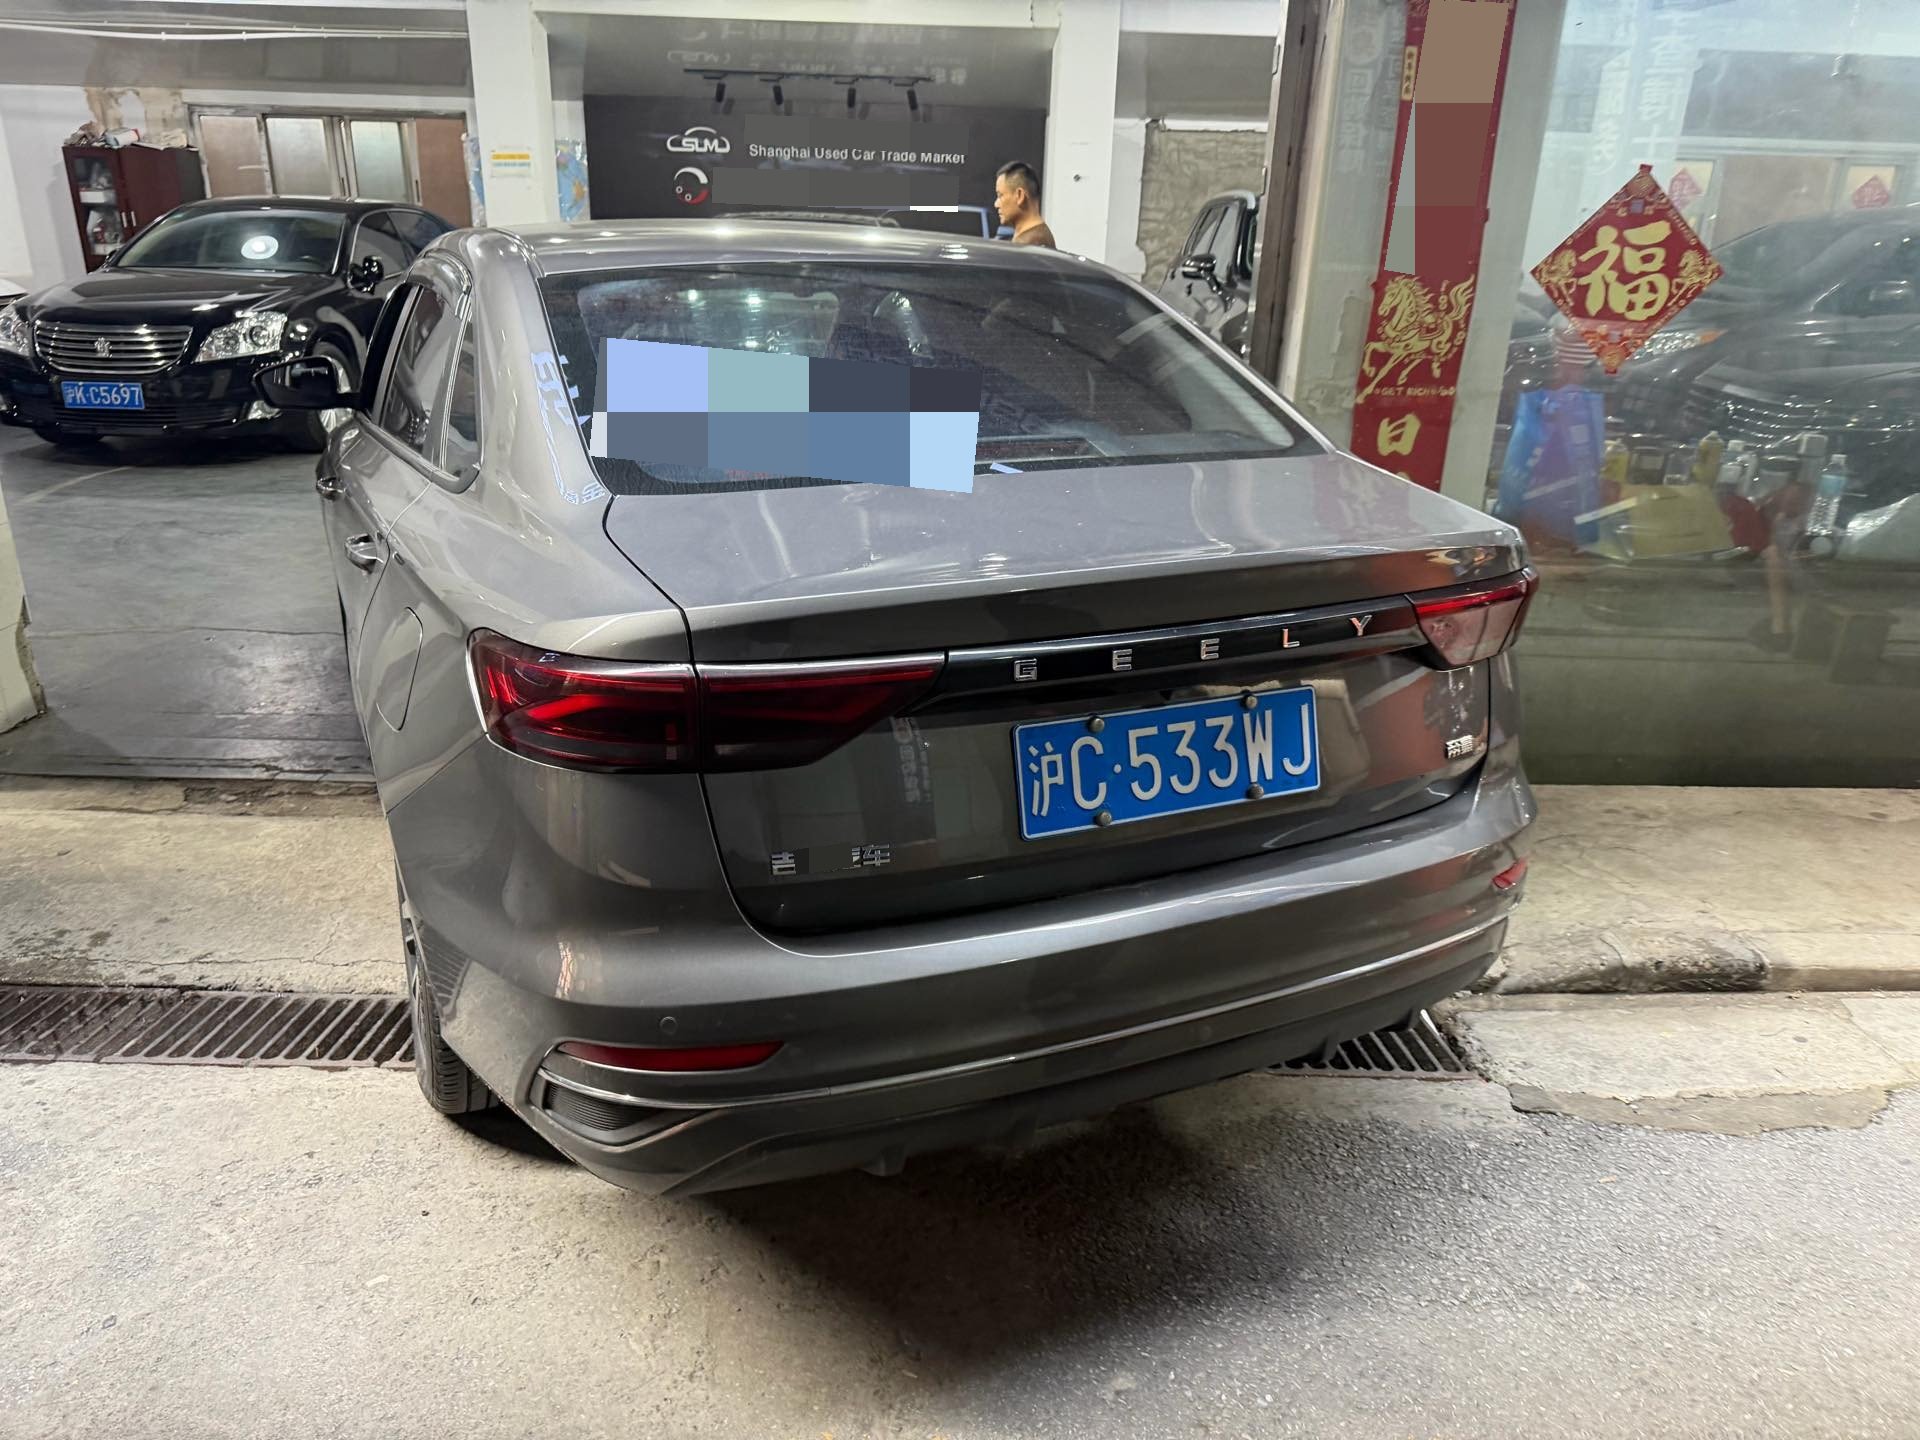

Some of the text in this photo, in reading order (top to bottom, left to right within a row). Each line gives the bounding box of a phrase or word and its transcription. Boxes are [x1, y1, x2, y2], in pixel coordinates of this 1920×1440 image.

[749, 144, 966, 165] Shanghai Used Car Trade Market
[1578, 220, 1673, 322] 福
[1014, 614, 1373, 682] GEELY
